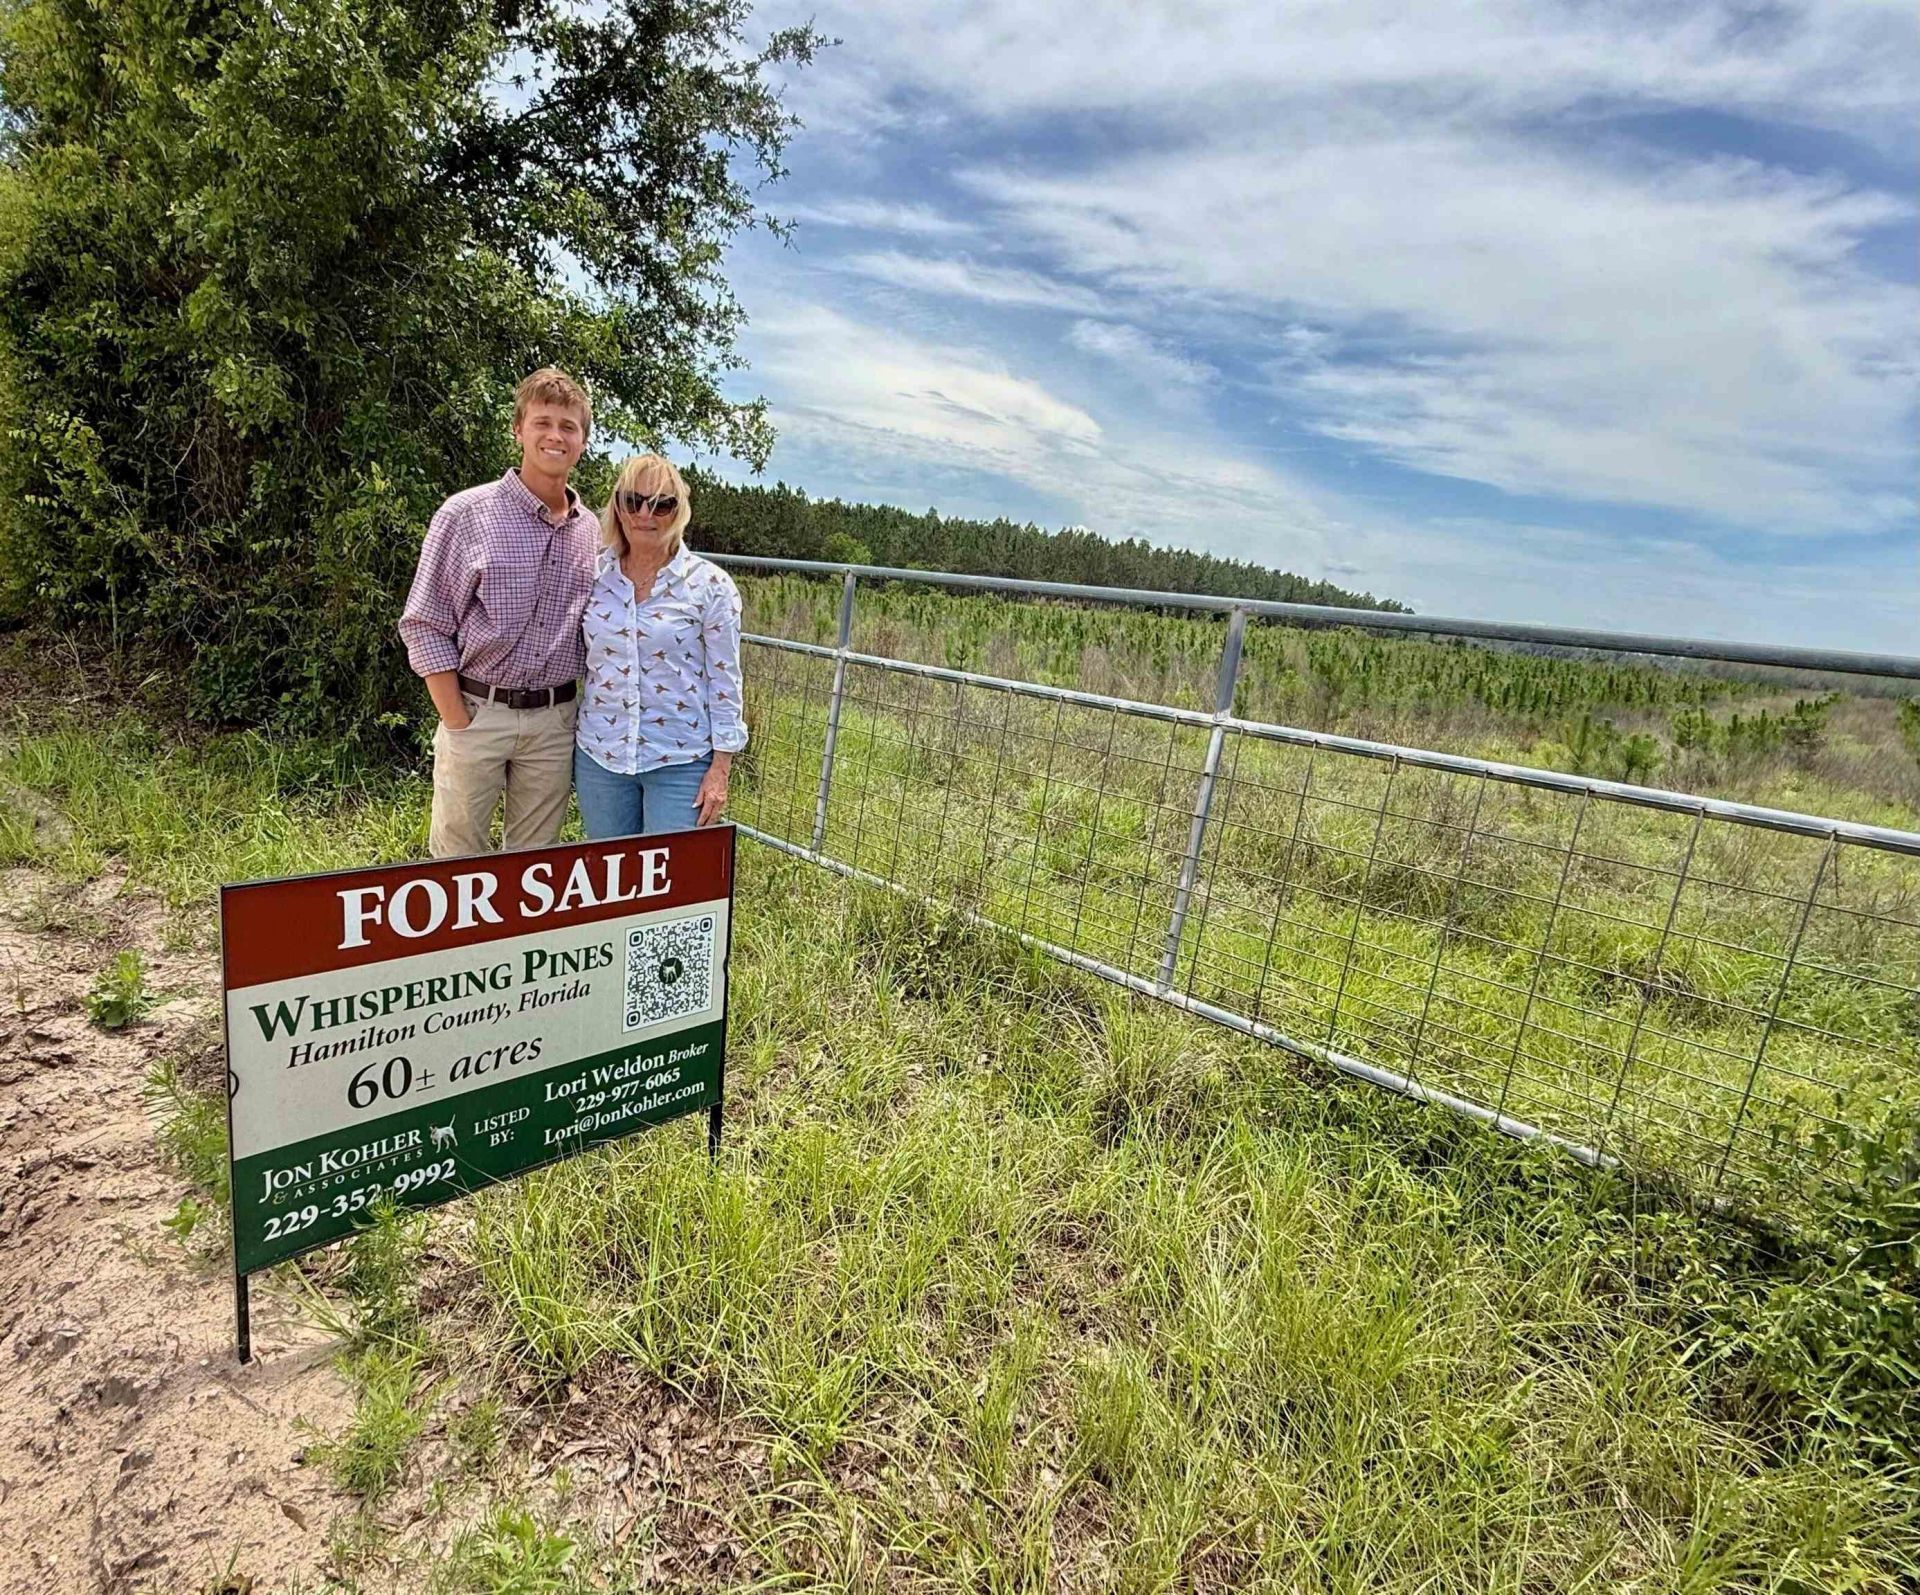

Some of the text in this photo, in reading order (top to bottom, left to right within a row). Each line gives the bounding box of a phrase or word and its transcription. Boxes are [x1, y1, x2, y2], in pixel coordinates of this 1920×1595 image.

[337, 847, 672, 950] FOR SALE
[250, 942, 614, 1042] WHISPERING PINES
[287, 979, 591, 1069] Hamilton County, Florida
[449, 1036, 542, 1083] acres
[544, 1042, 709, 1102] Lori Weldon Broker
[543, 1080, 705, 1147] Lori@JonKohler.com
[576, 1067, 680, 1113] 229-977-6065
[473, 1107, 531, 1135] LISTED
[489, 1129, 515, 1147] BY:
[259, 1129, 422, 1204] JON KOHLER
[273, 1148, 424, 1205] & ASSOCIATES
